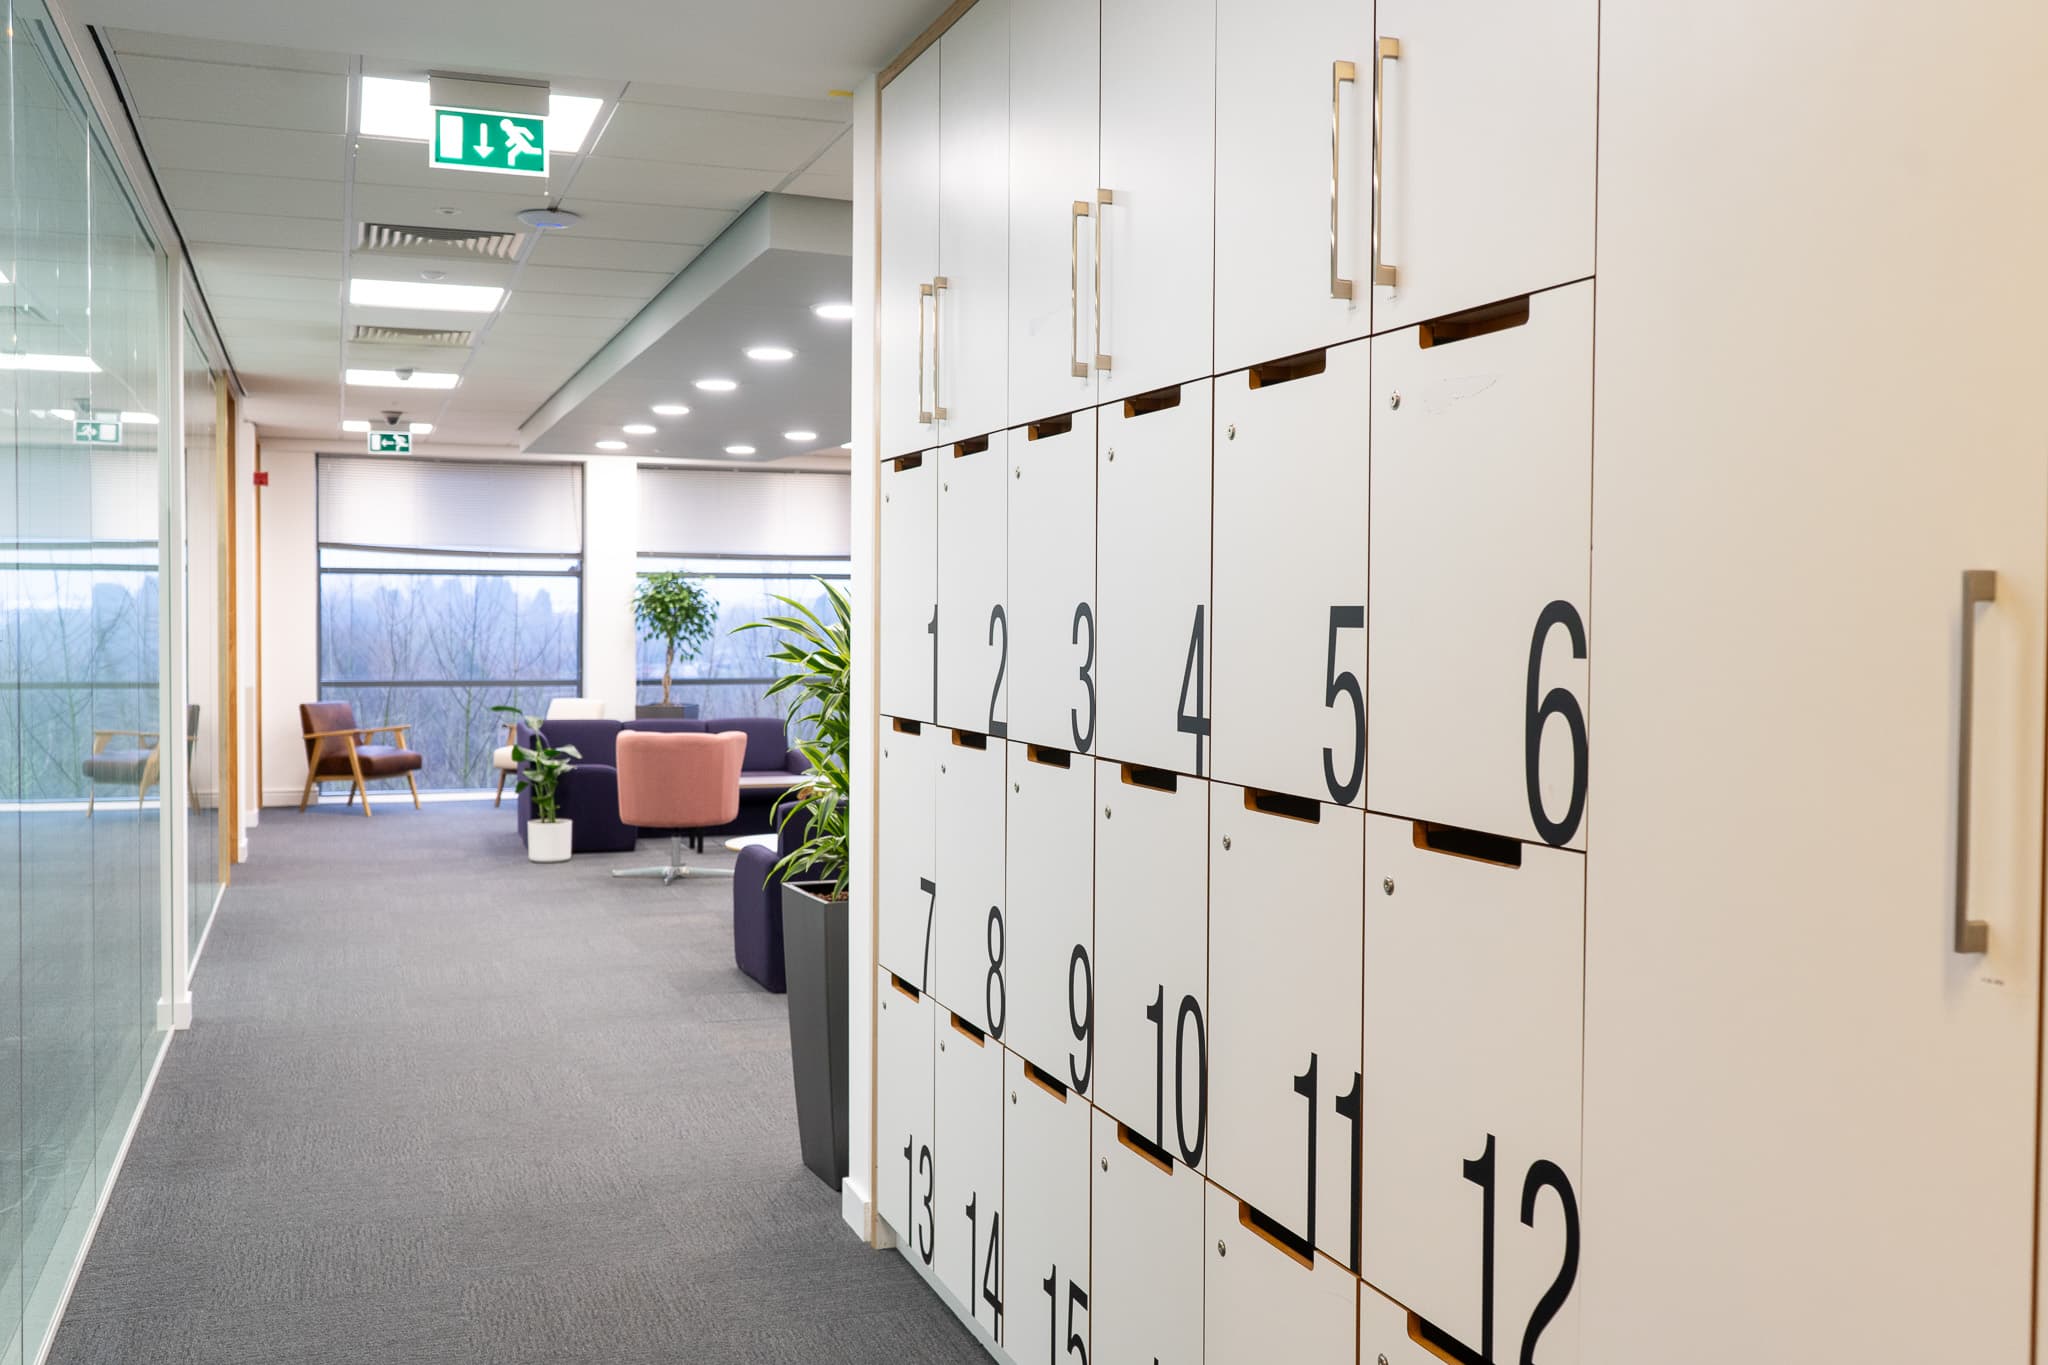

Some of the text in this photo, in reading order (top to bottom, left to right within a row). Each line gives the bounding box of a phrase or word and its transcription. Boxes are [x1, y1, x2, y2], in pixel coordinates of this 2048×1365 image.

[927, 604, 938, 725] 1
[989, 604, 1008, 738] 2
[1071, 602, 1096, 753] 3
[1177, 604, 1211, 778] 4
[1322, 605, 1365, 805] 5
[1525, 600, 1588, 847] 6
[920, 877, 936, 994] 7
[986, 906, 1006, 1040] 8
[1069, 944, 1094, 1095] 9
[1147, 985, 1207, 1168] 10
[904, 1134, 935, 1265] 13
[1294, 1053, 1363, 1273] 11
[966, 1191, 1003, 1343] 14
[1463, 1133, 1580, 1365] 12
